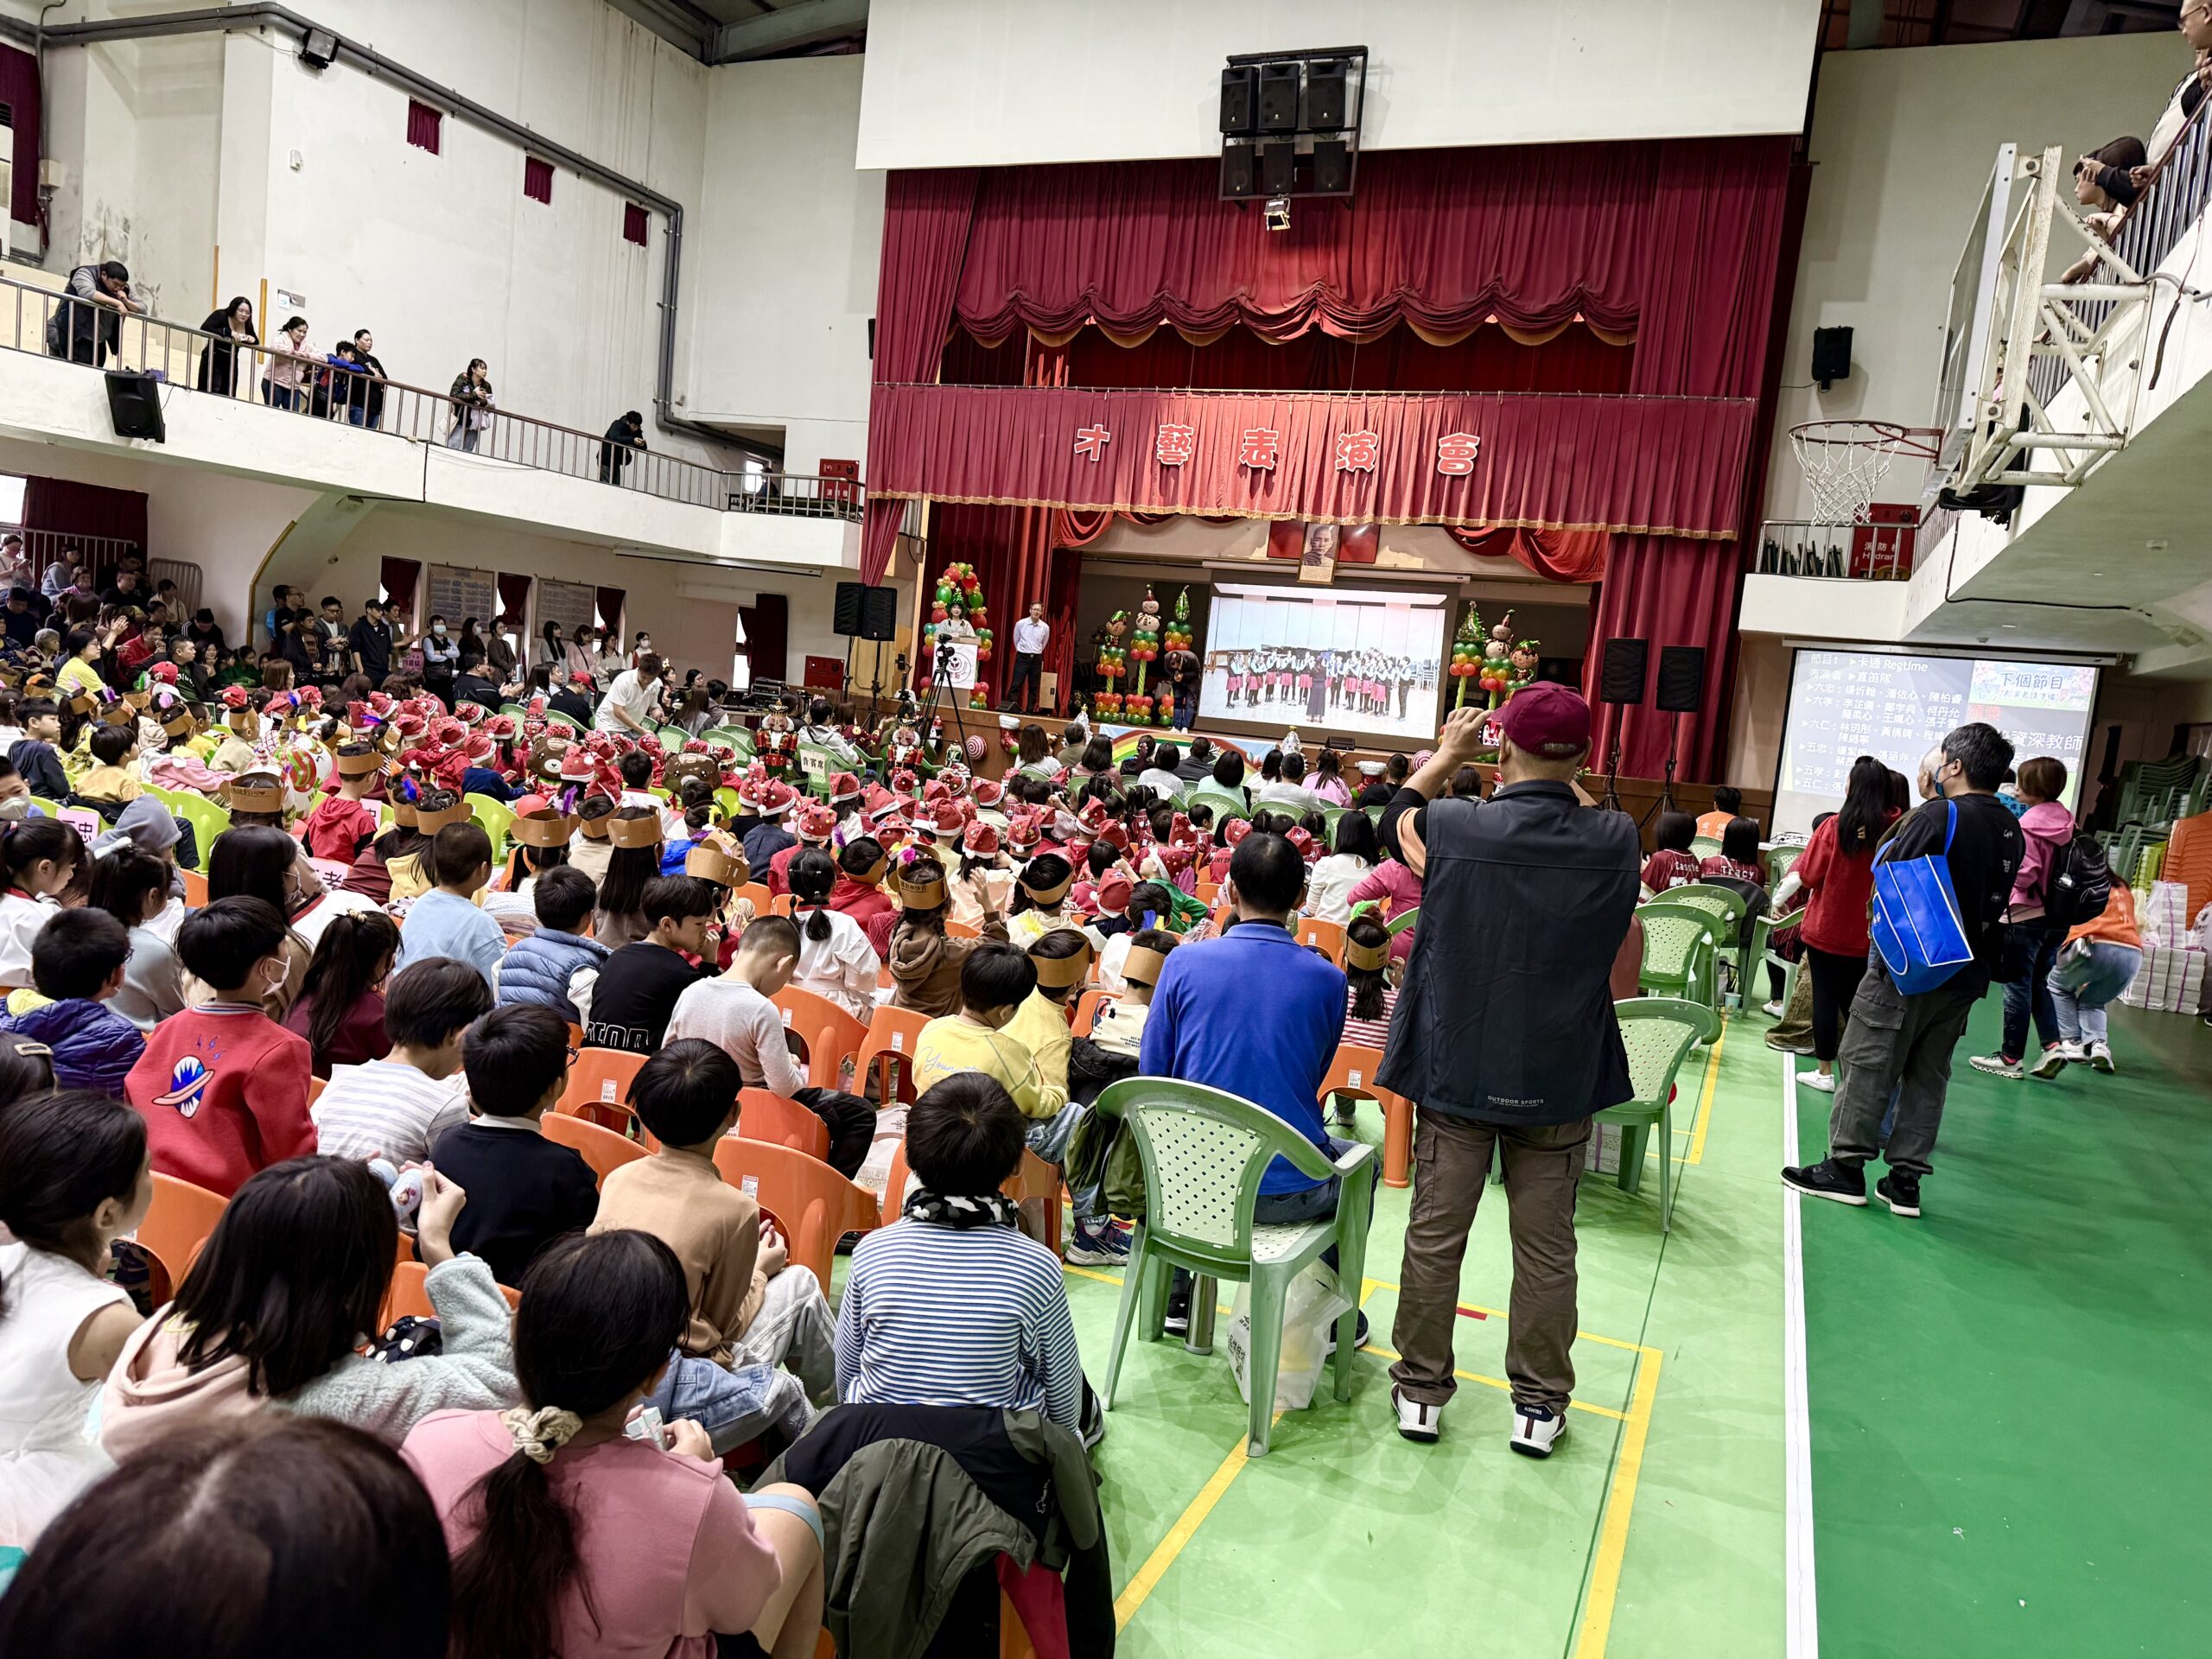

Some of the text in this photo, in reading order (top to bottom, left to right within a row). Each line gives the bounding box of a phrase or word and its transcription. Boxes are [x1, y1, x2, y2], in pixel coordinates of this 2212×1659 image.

[1074, 423, 1482, 476] 才藝表演會
[2000, 672, 2063, 690] 下個節目
[1721, 865, 1755, 880] Tracy
[1487, 1095, 1519, 1104] OUTDOOR
